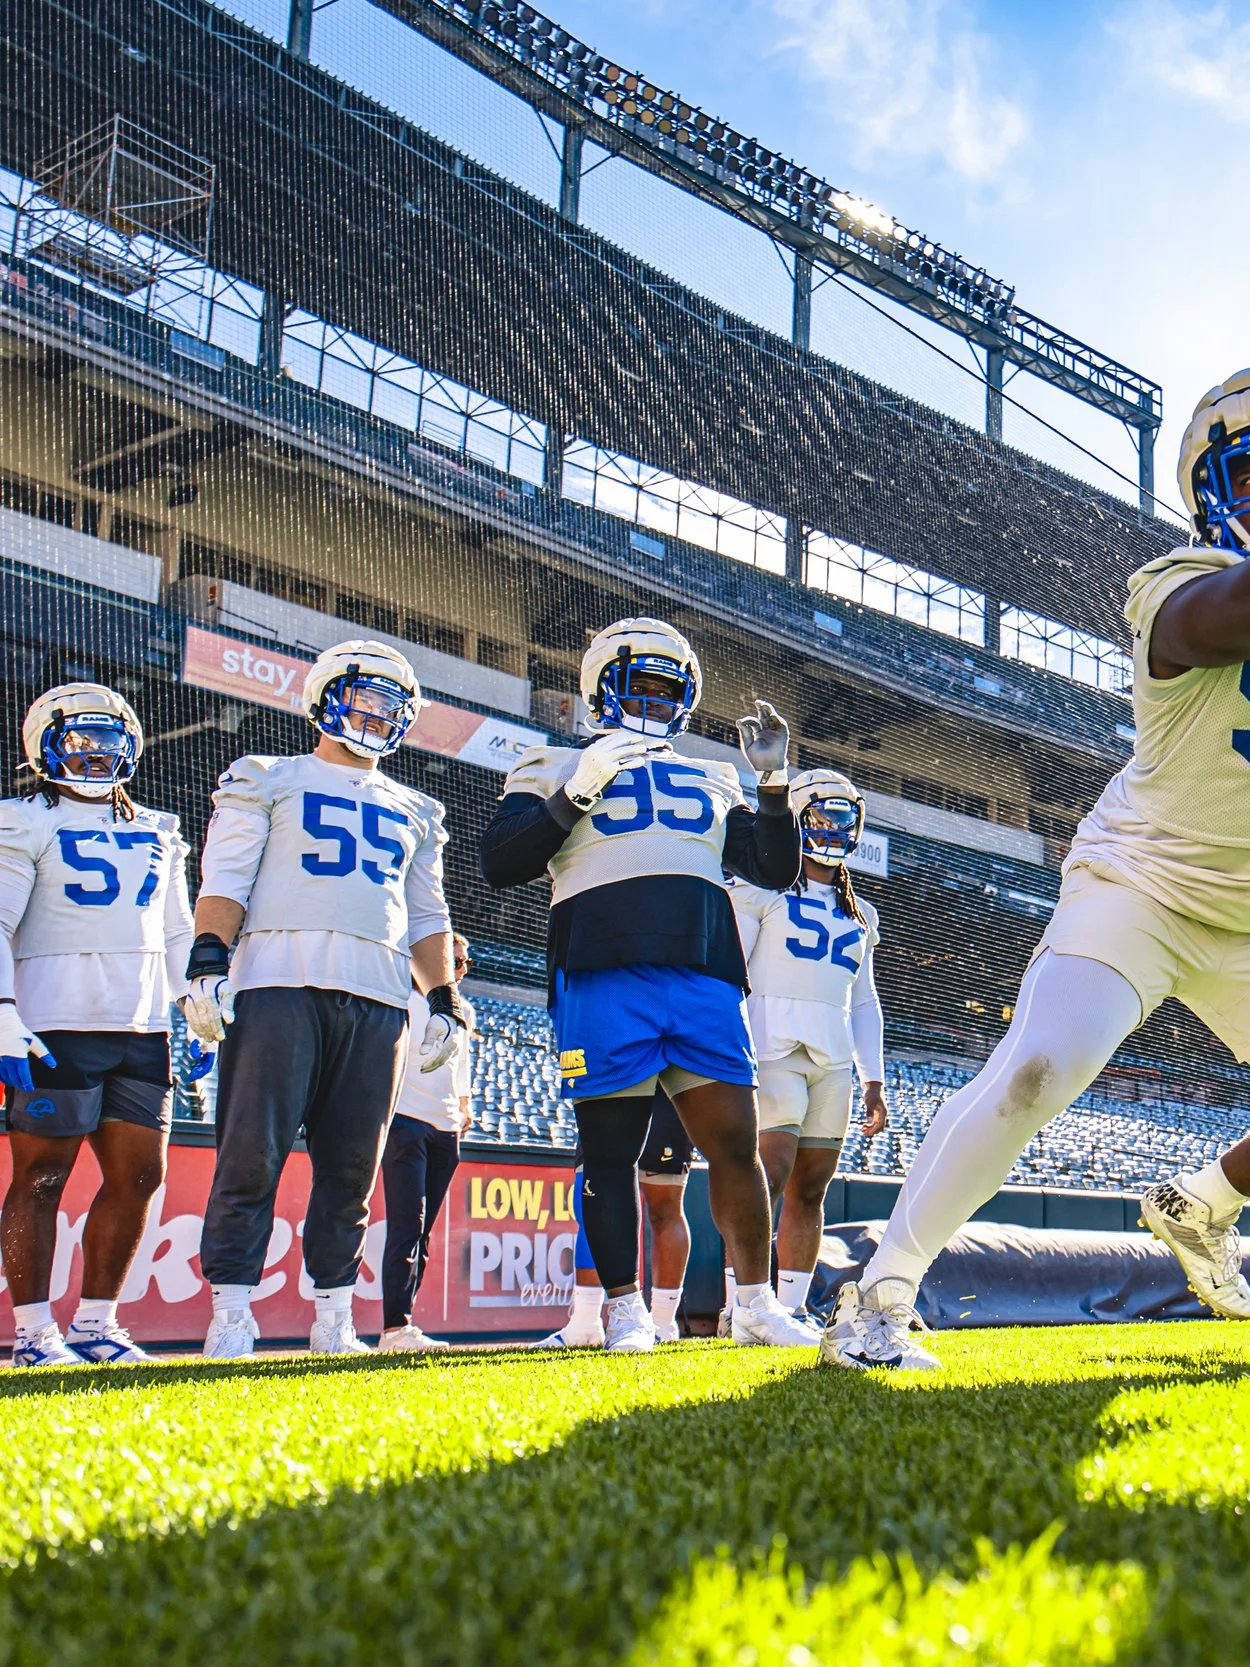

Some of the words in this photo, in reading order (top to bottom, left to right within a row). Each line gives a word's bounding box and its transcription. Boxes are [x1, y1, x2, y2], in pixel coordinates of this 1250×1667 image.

[222, 648, 297, 697] stay
[590, 759, 715, 836] 95
[56, 828, 163, 907] 57
[301, 791, 409, 885] 55
[784, 894, 866, 975] 52
[471, 1177, 549, 1230] LOW,
[469, 1232, 576, 1291] PRIC
[520, 1282, 575, 1318] every
